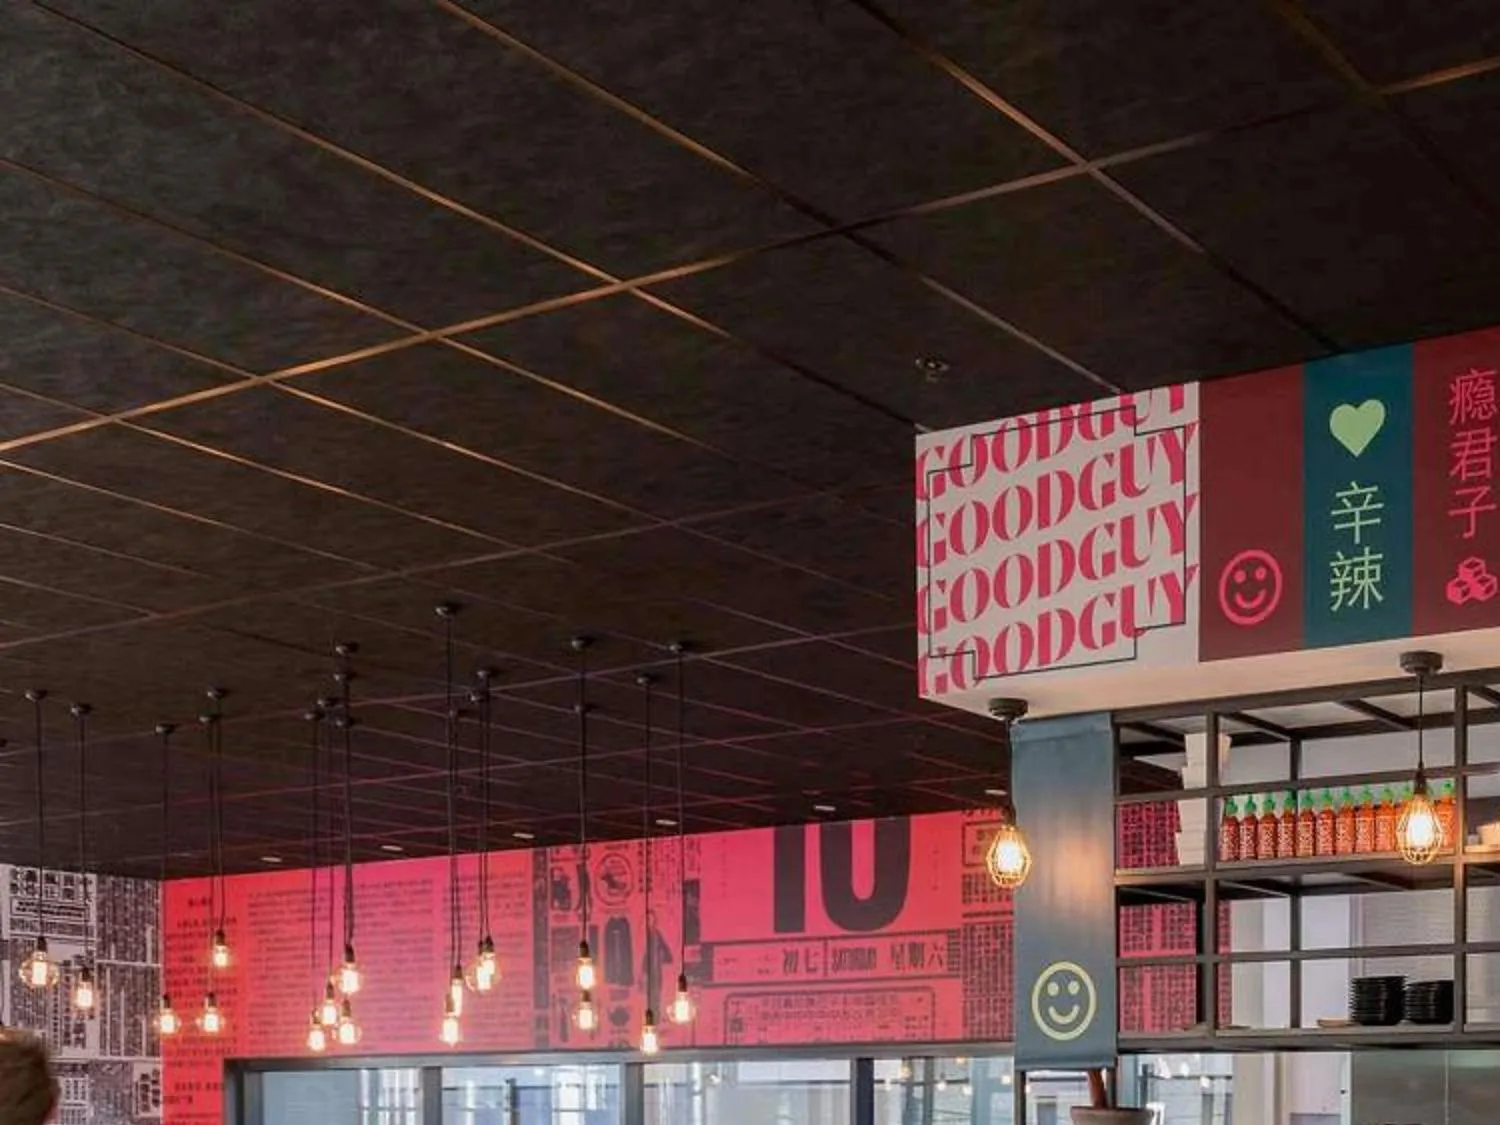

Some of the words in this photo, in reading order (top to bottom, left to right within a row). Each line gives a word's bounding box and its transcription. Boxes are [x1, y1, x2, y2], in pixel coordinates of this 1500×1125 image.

[916, 420, 1199, 568] GOODGUY
[1448, 368, 1499, 540] 瘾君子
[917, 492, 1199, 635] GOODGUY
[1329, 481, 1385, 612] 辛辣
[918, 564, 1199, 695] GOODGUY
